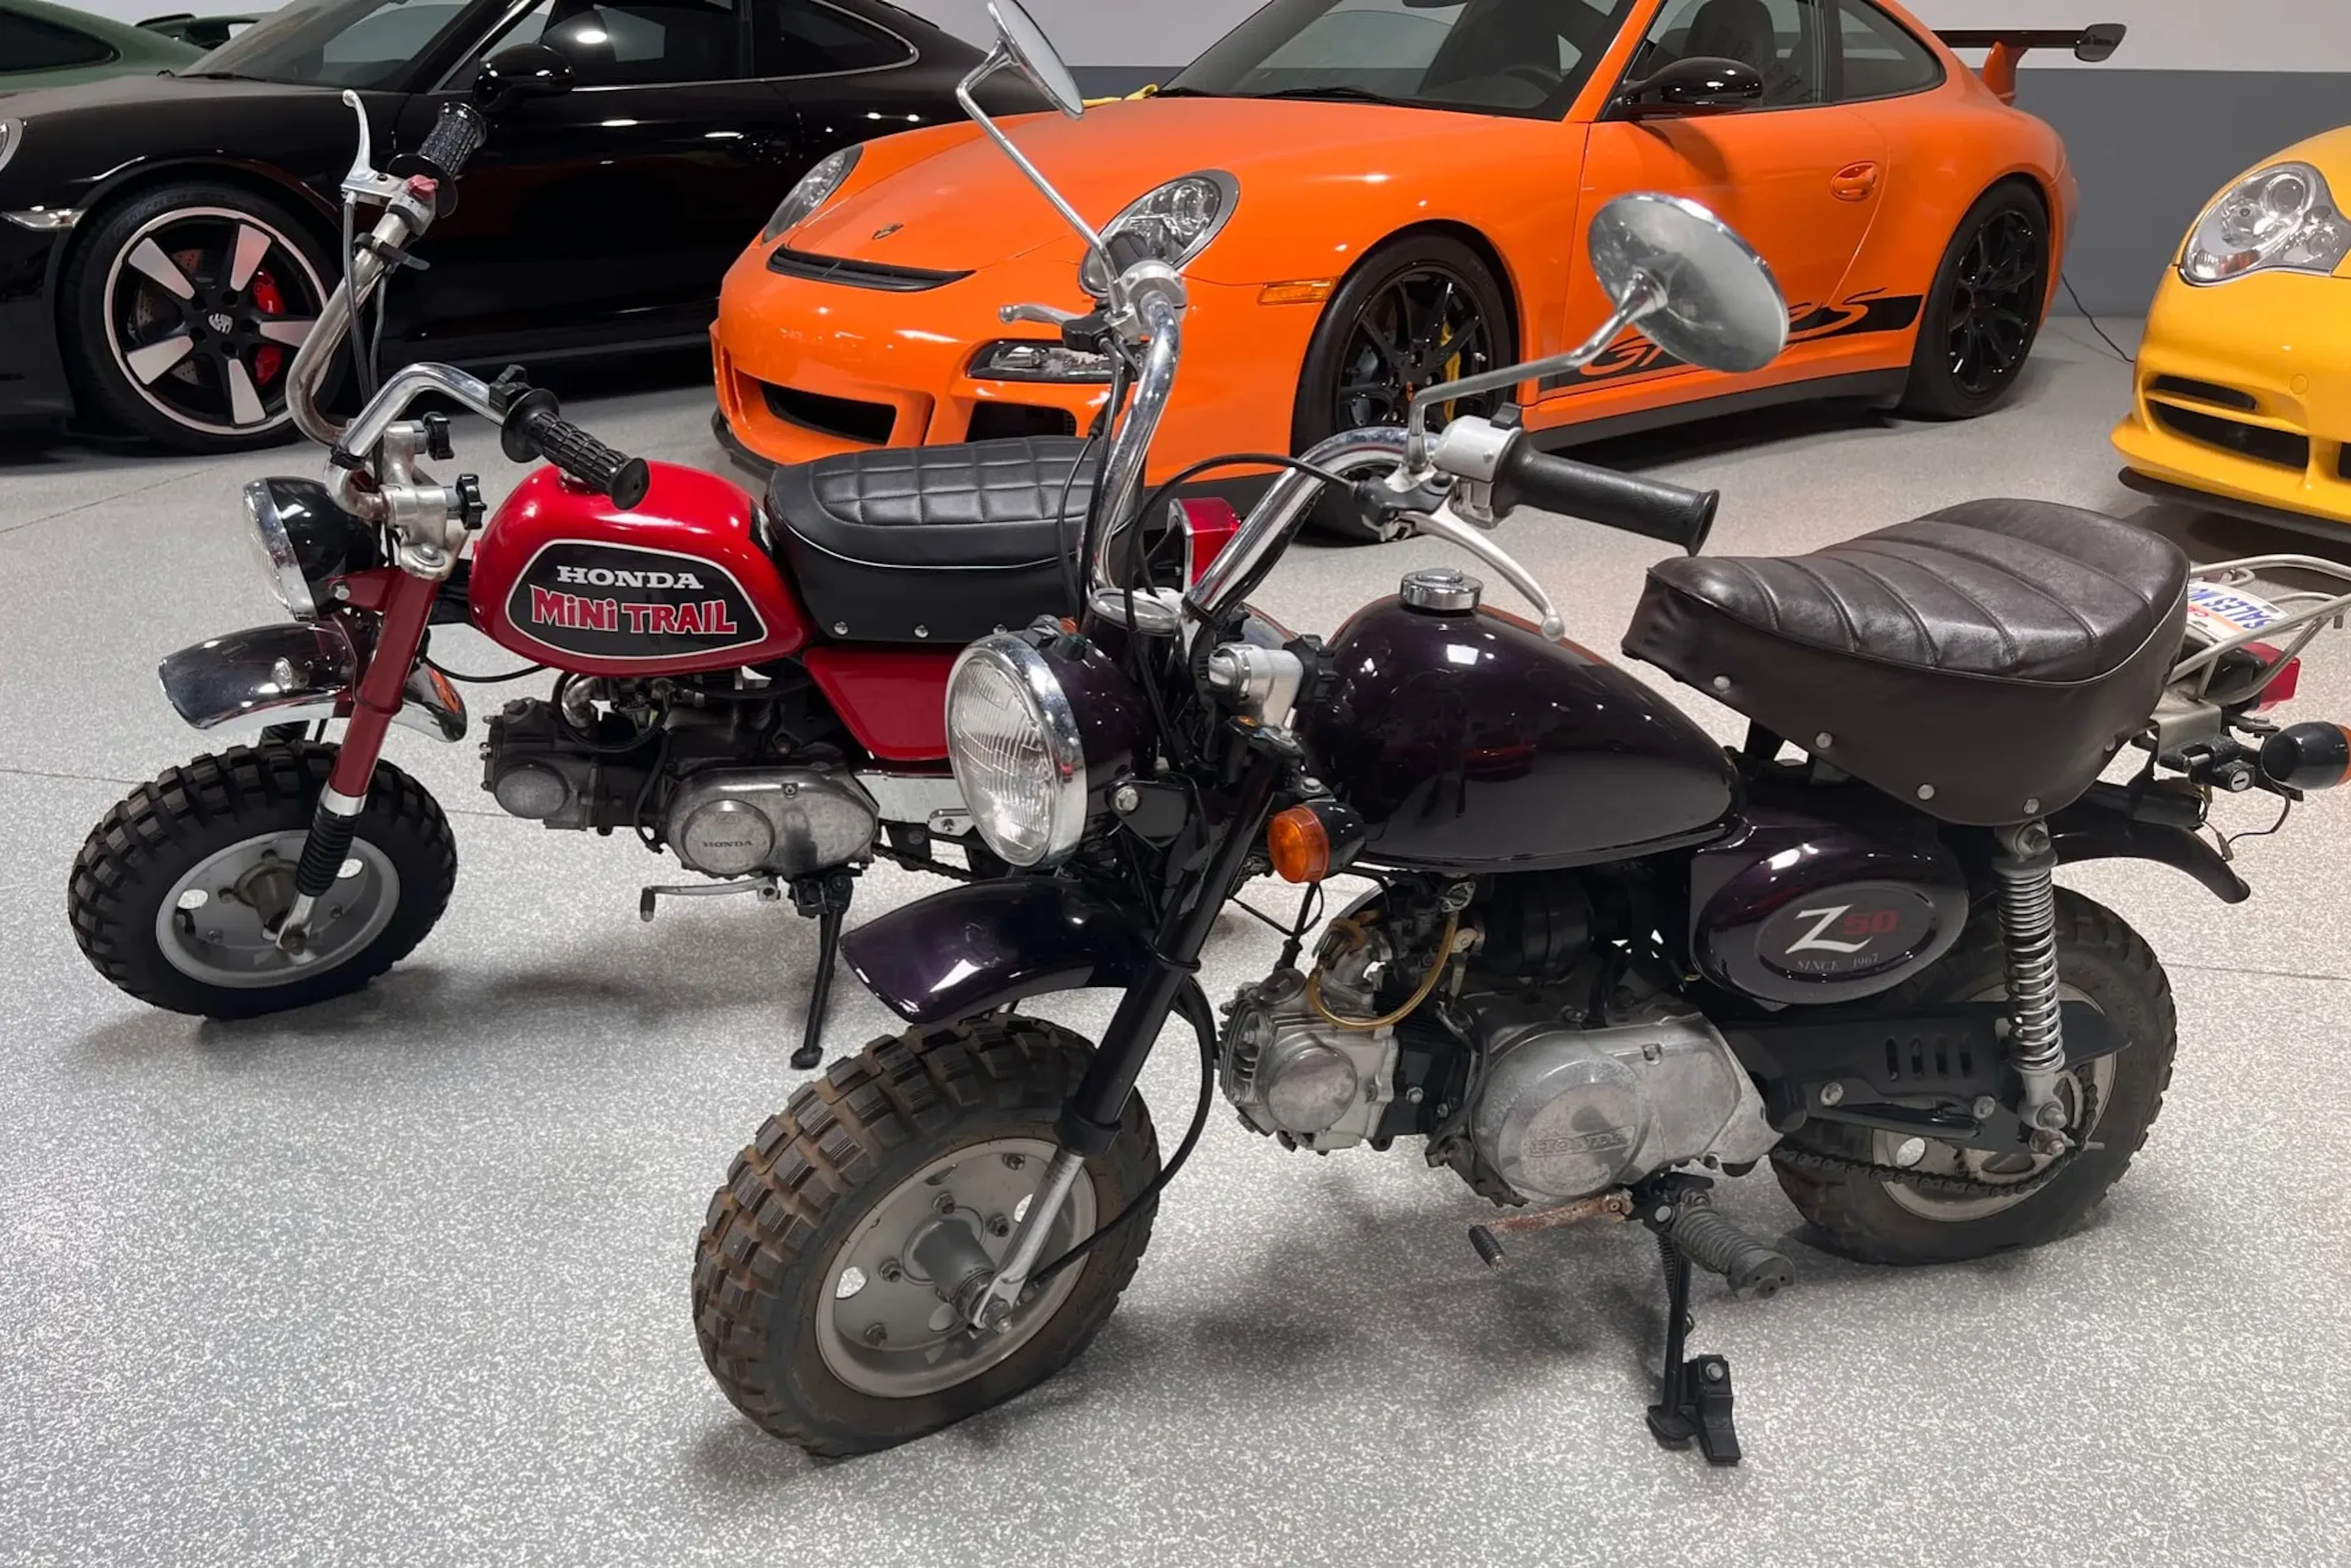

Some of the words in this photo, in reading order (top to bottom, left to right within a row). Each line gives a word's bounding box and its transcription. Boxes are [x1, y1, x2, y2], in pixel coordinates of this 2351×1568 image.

[557, 565, 703, 589] HONDA
[621, 599, 737, 634] TRAIL
[1797, 959, 1840, 971] SINCE
[1531, 1133, 1628, 1154] HONDA
